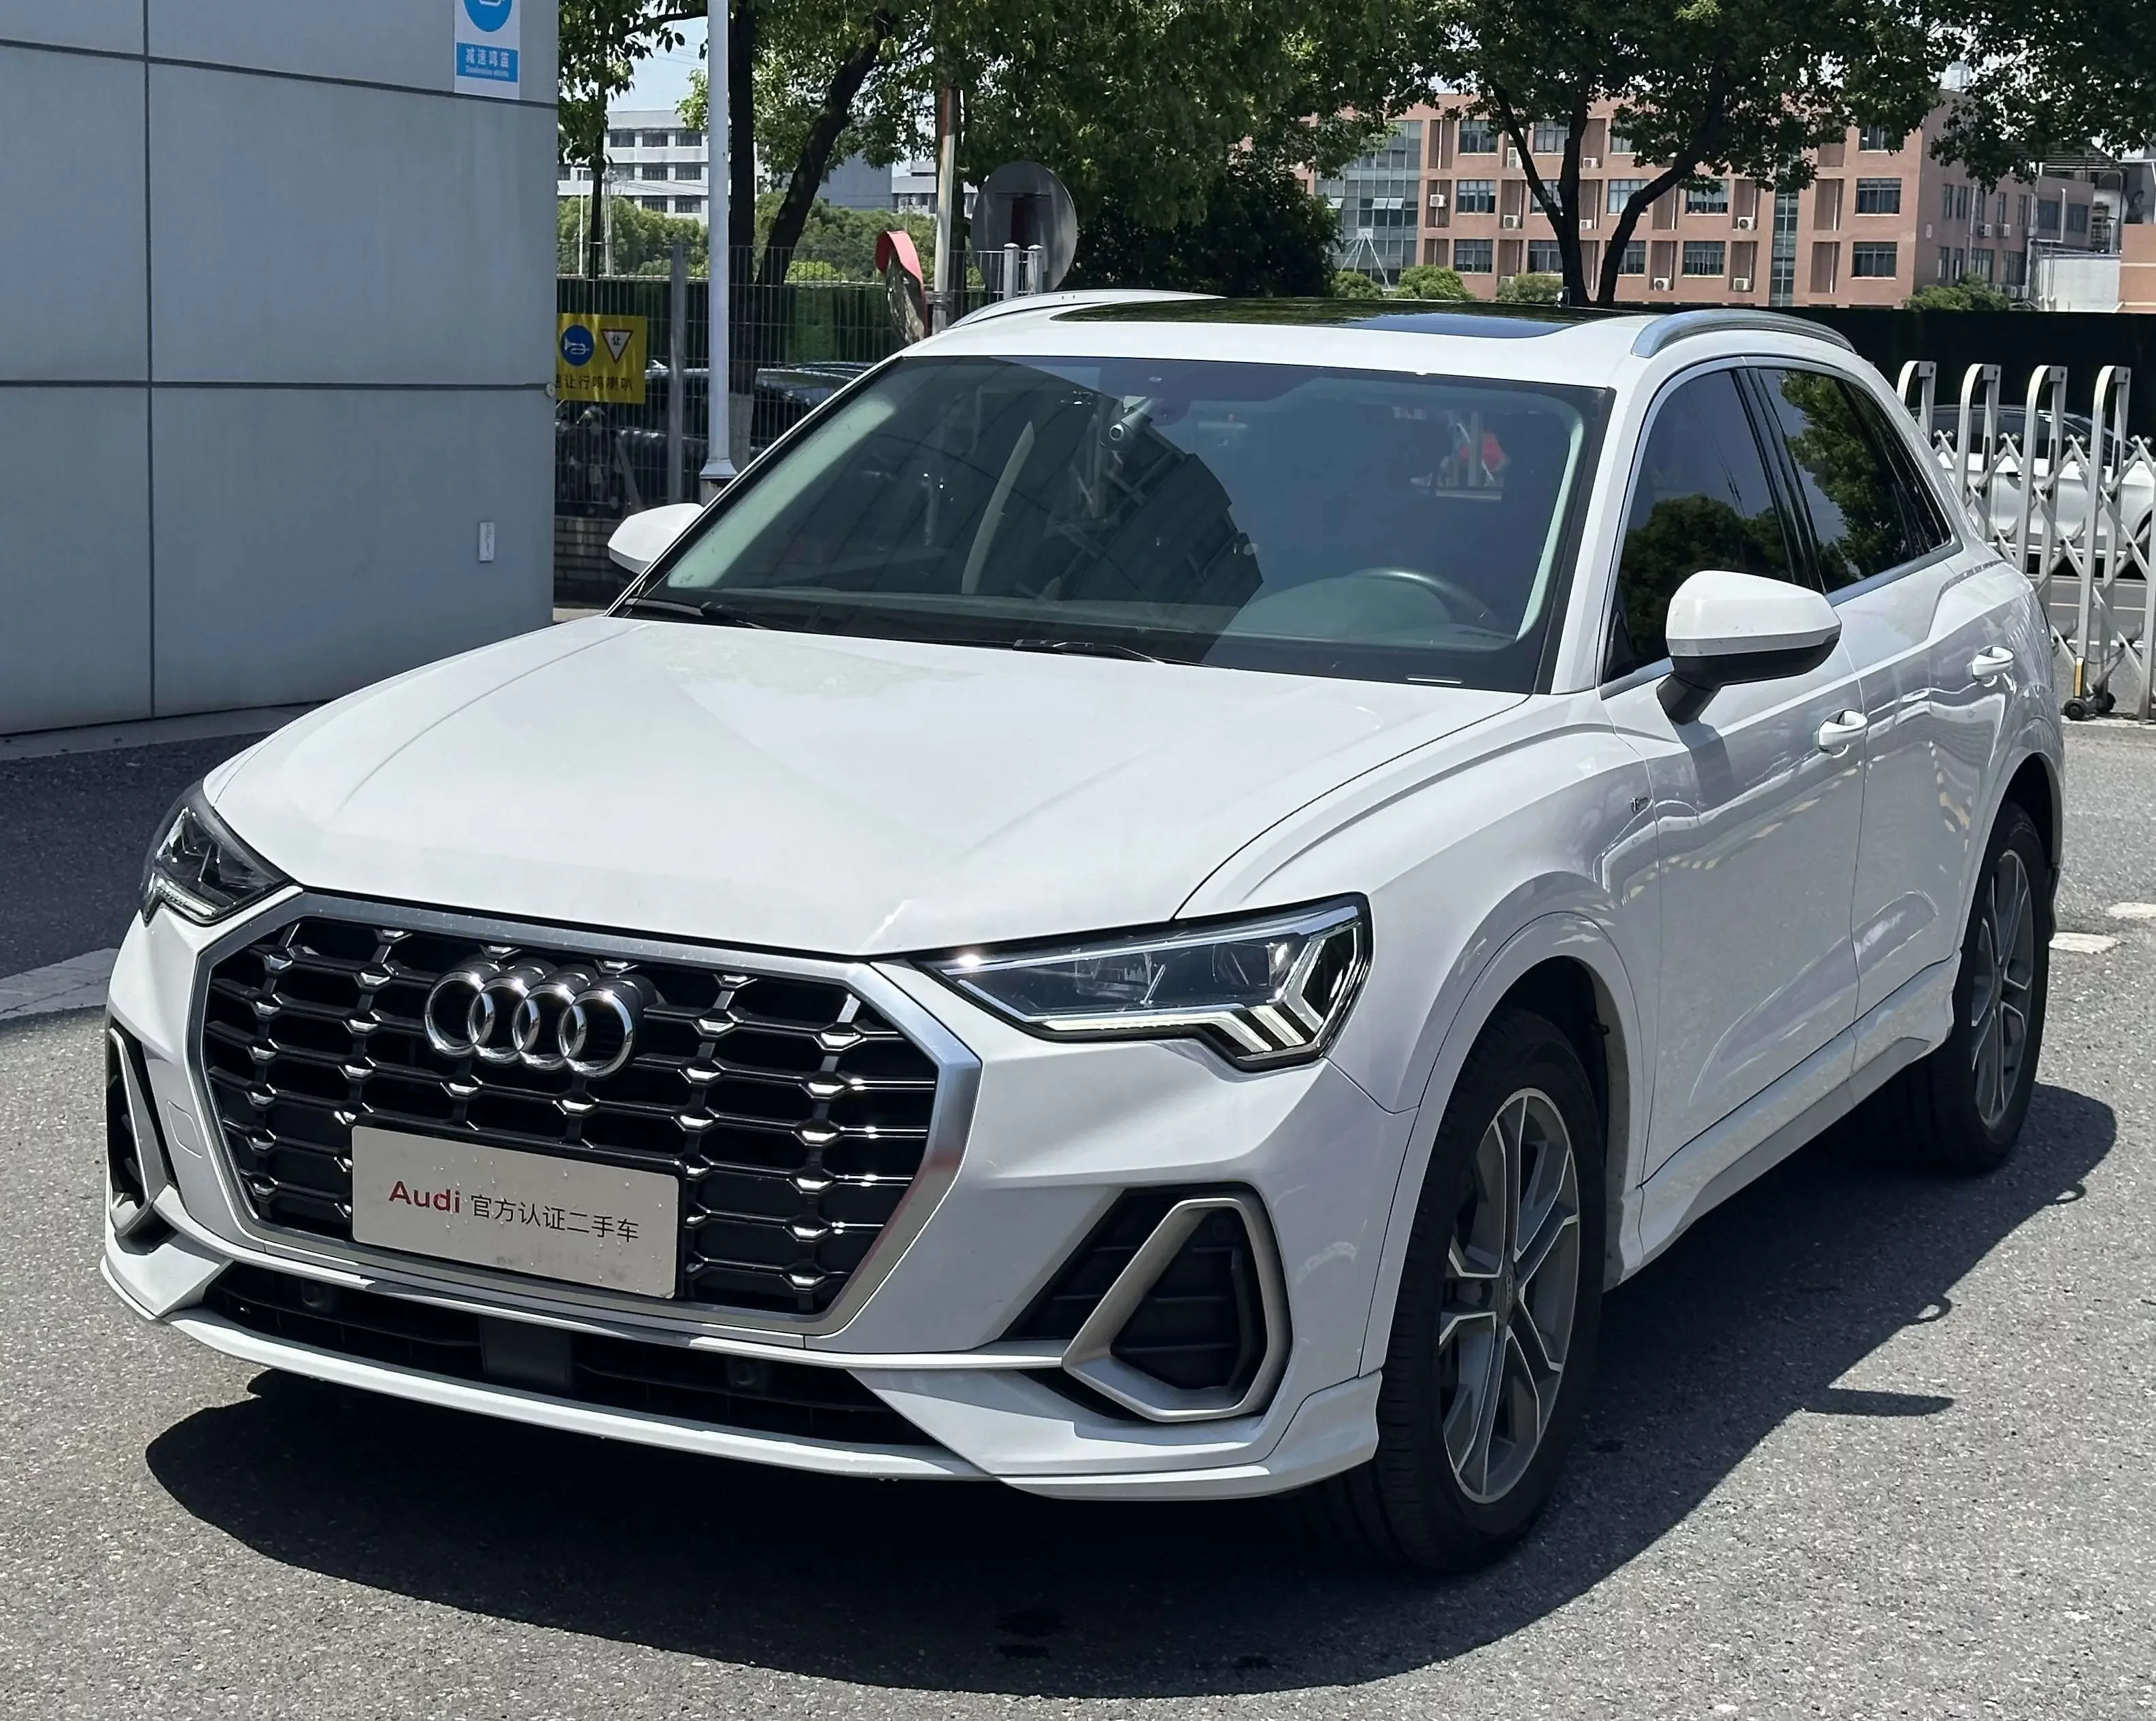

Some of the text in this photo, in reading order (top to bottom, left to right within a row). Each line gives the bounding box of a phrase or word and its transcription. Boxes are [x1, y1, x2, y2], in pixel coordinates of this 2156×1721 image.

[611, 335, 621, 346] 让
[389, 1181, 639, 1242] Audi 官方认证二手车
